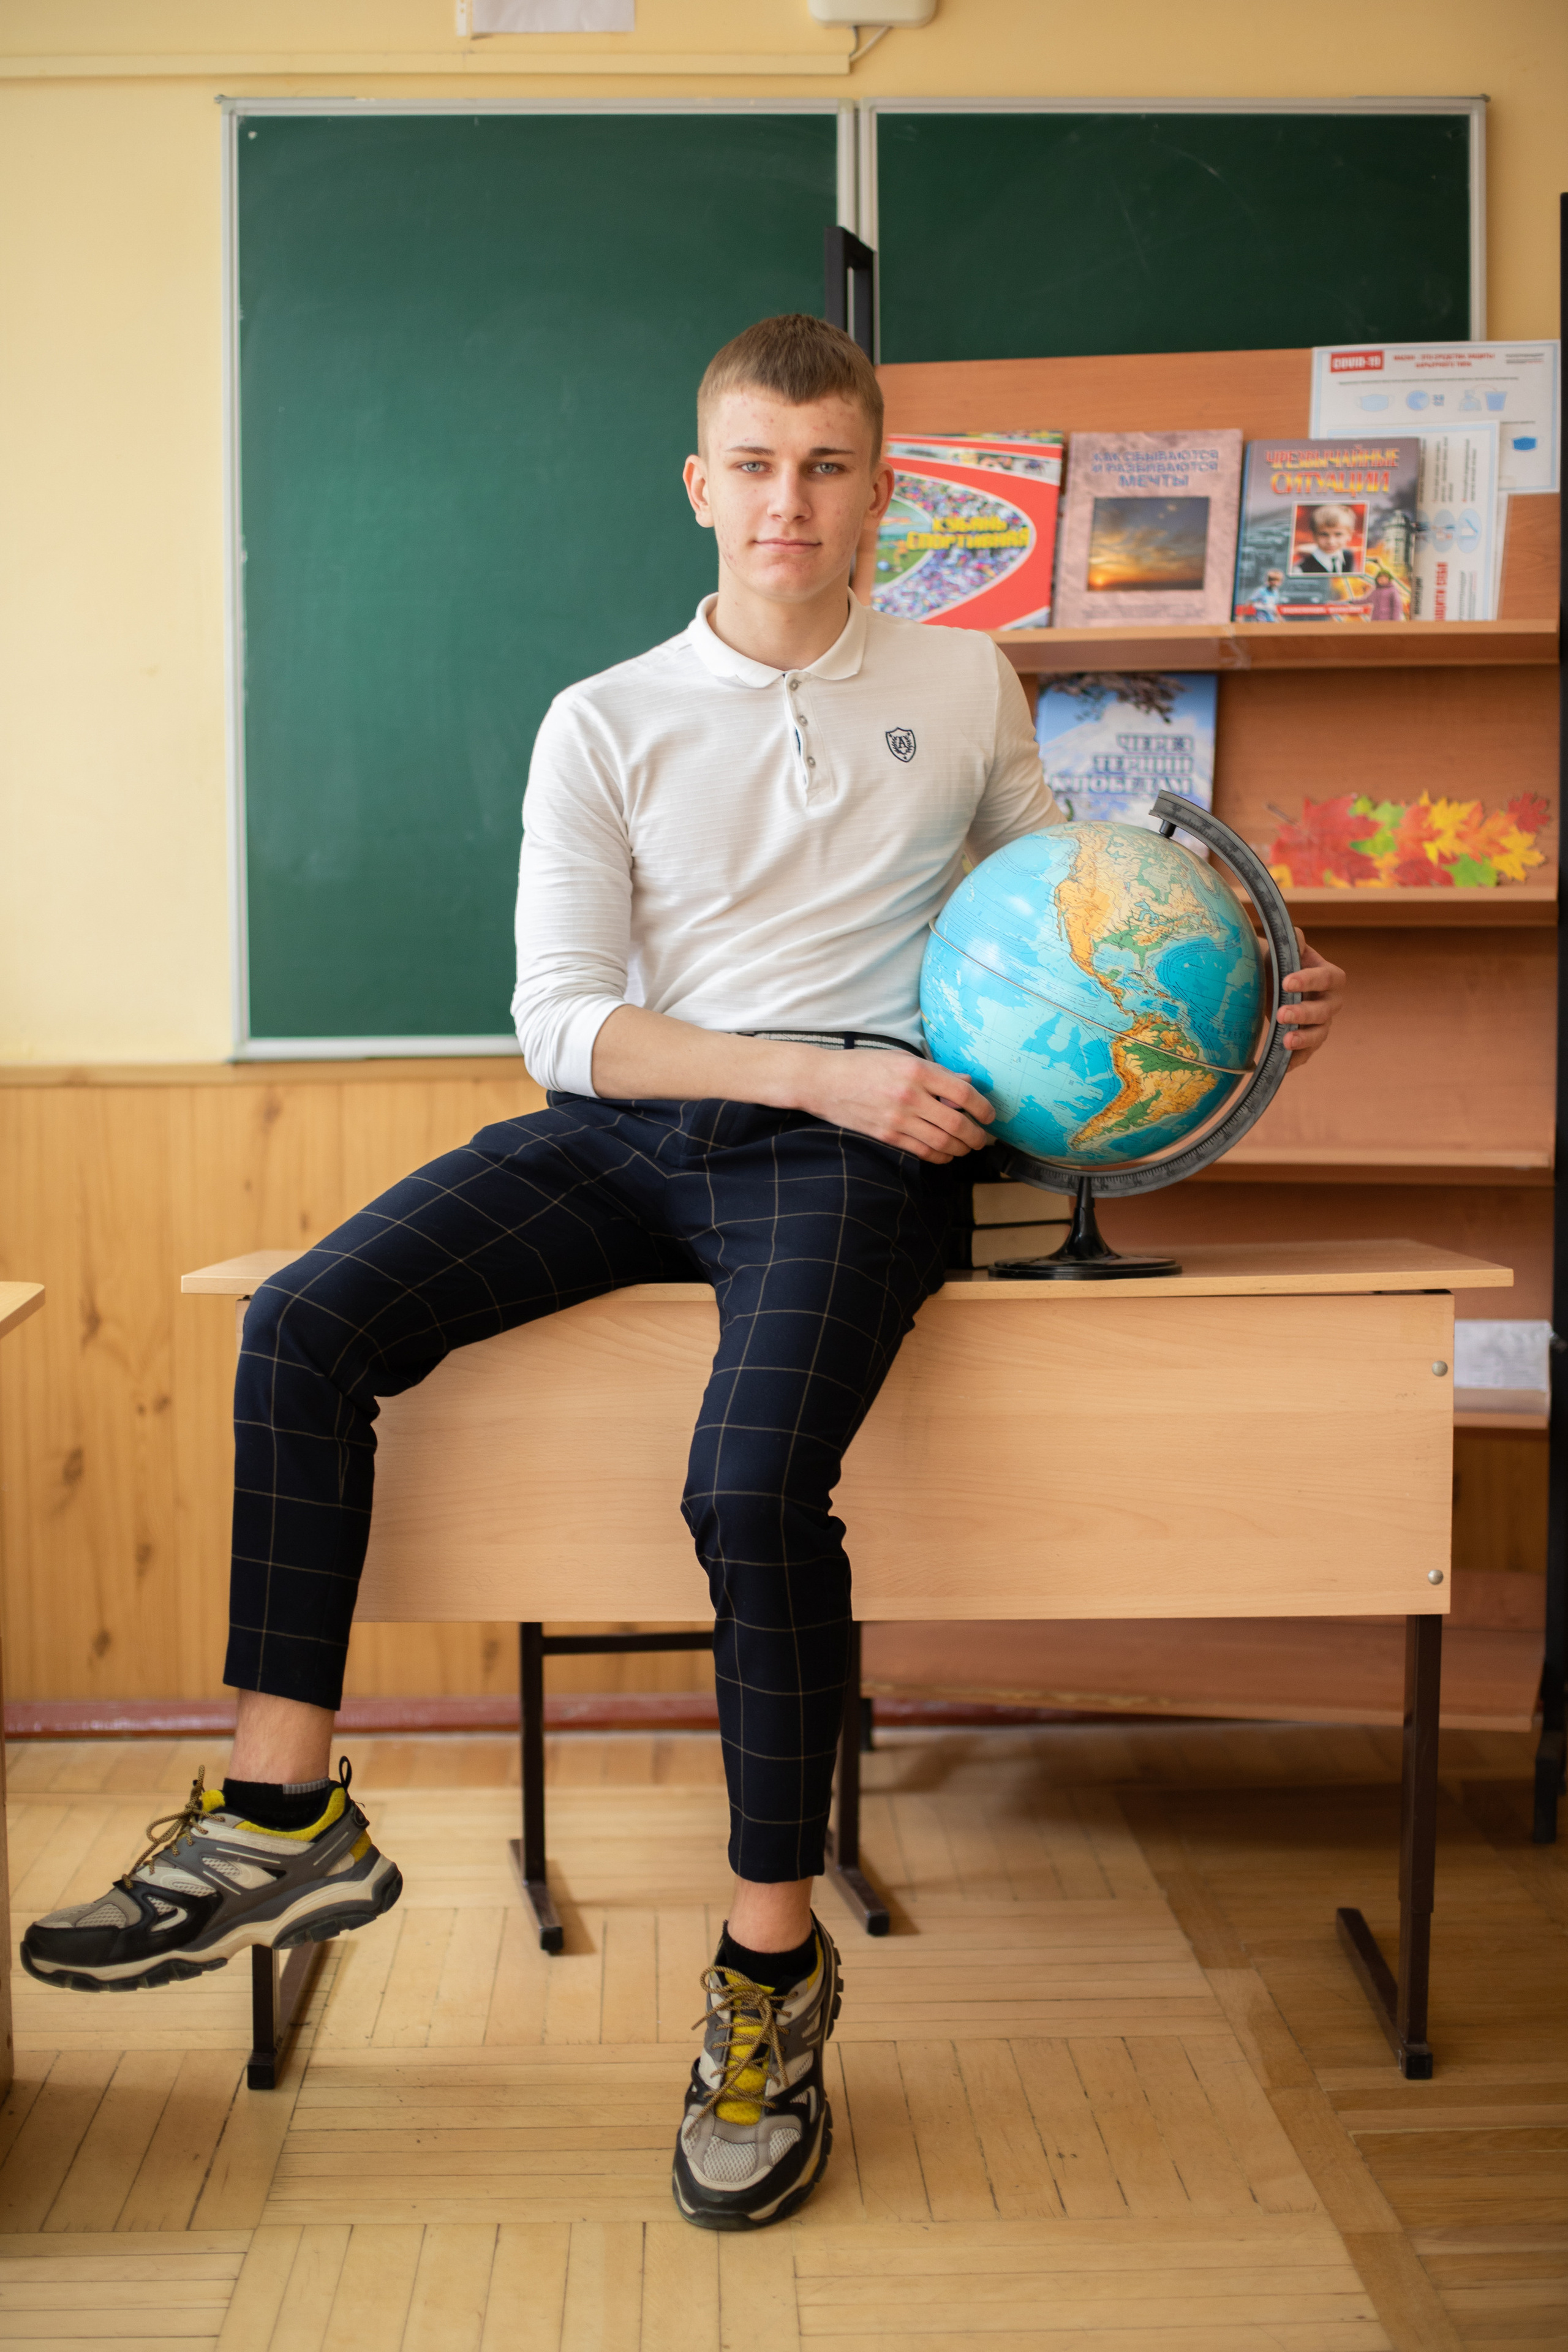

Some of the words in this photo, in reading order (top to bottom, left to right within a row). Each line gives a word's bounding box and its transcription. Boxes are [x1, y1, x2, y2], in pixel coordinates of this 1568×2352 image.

[1333, 355, 1381, 369] COVID-19
[1094, 452, 1120, 461] КАК
[1124, 450, 1219, 461] СБЫВАЮТСЯ
[1265, 444, 1400, 469] ЧРЕЗВЫЧАЙНЫЕ
[1092, 464, 1102, 473] И
[1106, 461, 1218, 473] РАЗБИВАЮТСЯ
[1119, 474, 1188, 488] МЕЧТЫ
[1271, 470, 1390, 497] СИТУАЦИИ
[932, 516, 1008, 532] КУБАНЬ
[907, 527, 1030, 549] СПОРТИВНАЯ
[1117, 734, 1194, 753] ЧЕРЕЗ
[1093, 755, 1194, 774] ТЕРНИИ
[1074, 775, 1193, 794] ПОБЕДАМ
